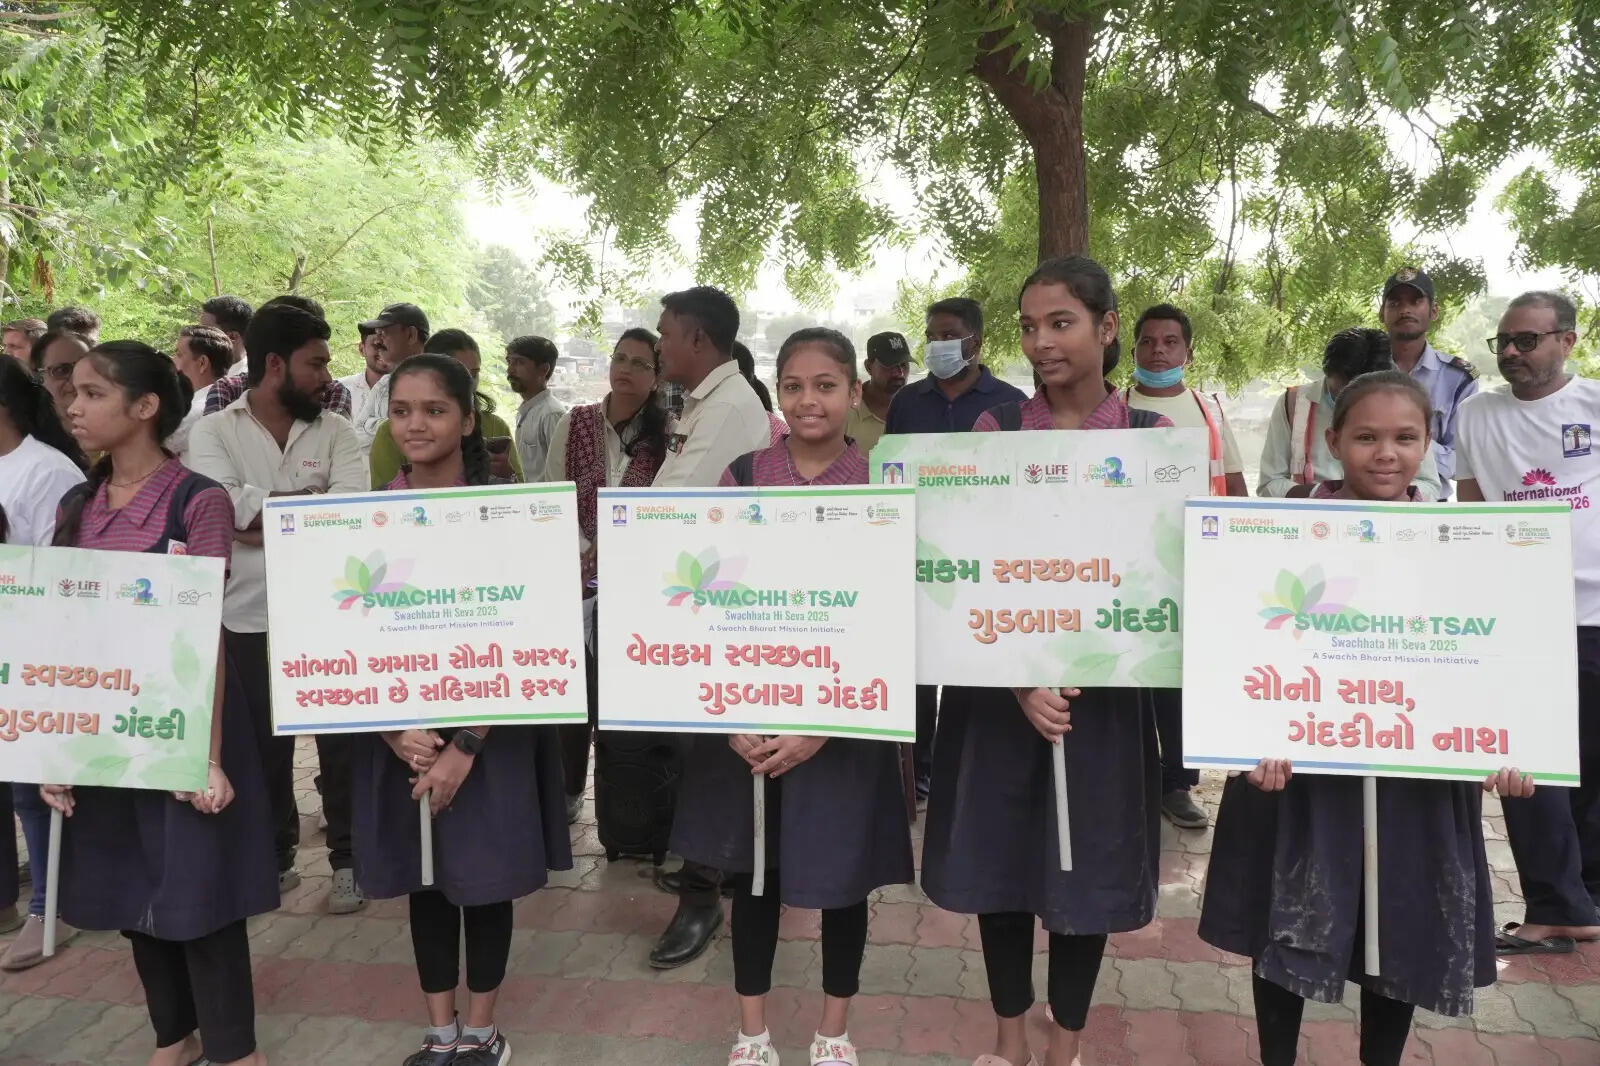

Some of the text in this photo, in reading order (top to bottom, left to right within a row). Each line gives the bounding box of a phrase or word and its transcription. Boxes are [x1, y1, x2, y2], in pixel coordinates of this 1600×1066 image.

[918, 465, 977, 476] SWACHH
[1045, 464, 1068, 475] LiFE
[918, 475, 1010, 486] SURVEKSHAN
[635, 505, 676, 513] SWACHH
[304, 512, 341, 521] SWACHH
[304, 518, 362, 527] SURVEKSHAN
[636, 512, 697, 521] SURVEKSHAN
[1229, 517, 1275, 527] SWACHH
[1229, 525, 1300, 535] SURVEKSHAN
[916, 557, 1121, 587] લકમ સ્વચ્છતા,
[77, 580, 101, 592] LiFE
[394, 605, 499, 621] Swachhata Hi Seva 2025
[725, 610, 829, 622] Swachhata Hi Seva 2025
[387, 624, 418, 632] Swachh
[419, 623, 447, 631] Bharat
[449, 621, 478, 629] Mission
[480, 619, 515, 628] Initiative
[967, 597, 1179, 644] ગુડબાય ગંદકી
[717, 624, 747, 632] Swachh
[749, 625, 777, 633] Bharat
[810, 626, 846, 634] Initiative
[1331, 636, 1458, 652] Swachhata Hi Seva 2025
[282, 642, 577, 678] સાંભળો અમારા સૌની અરજ,
[626, 633, 841, 674] વેલકમ સ્વચ્છતા,
[1312, 652, 1480, 666] A Swachh Bharat Mission Initiative
[21, 663, 140, 696] સ્વચ્છતા,
[295, 672, 568, 708] સ્વચ્છતા છે સહિયારી ફરજ
[1243, 664, 1416, 712] સૌનો સાથ,
[698, 676, 889, 716] ગુડબાય ગંદકી
[112, 707, 186, 740] ગંદકી
[1287, 710, 1509, 755] ગંદકીનો નાશ
